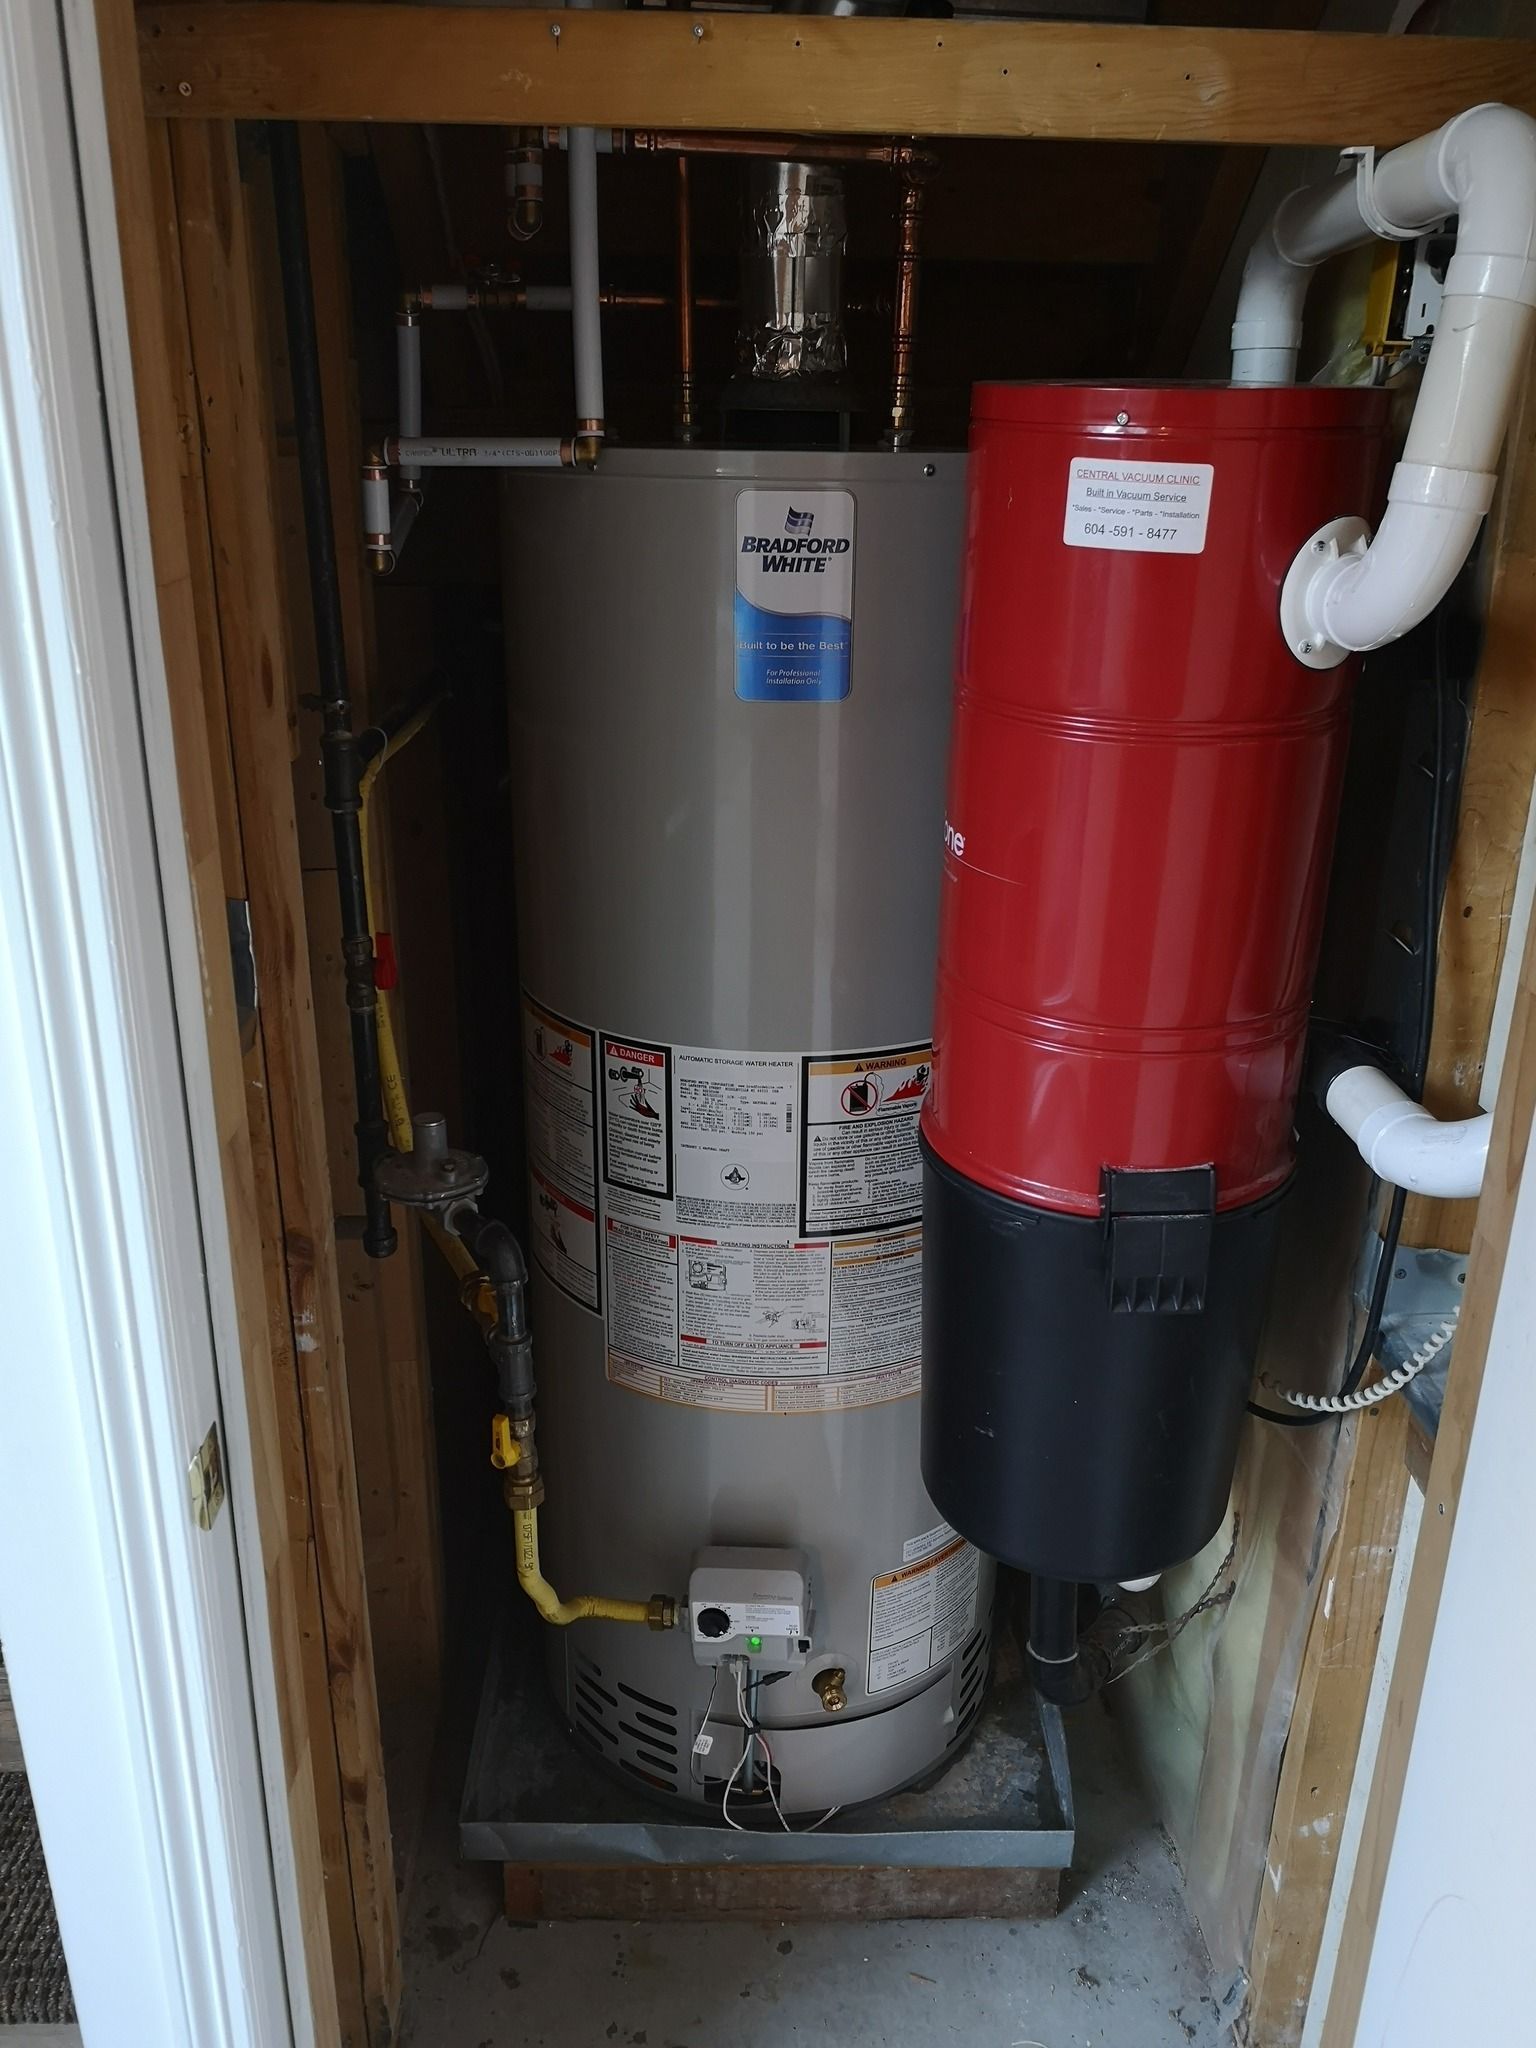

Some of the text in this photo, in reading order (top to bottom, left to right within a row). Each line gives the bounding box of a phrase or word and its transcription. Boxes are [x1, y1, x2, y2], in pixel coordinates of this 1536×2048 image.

[442, 448, 476, 457] ULTRA
[1076, 468, 1200, 485] CENTRAL VACUUM CLINIC
[1086, 487, 1187, 502] Built in Vacuum Service
[1084, 523, 1105, 535] 604
[1146, 528, 1178, 540] 8477
[741, 536, 850, 554] BRADFORD
[762, 555, 826, 573] WHITE
[739, 641, 844, 651] Built to be the Best
[778, 669, 821, 677] Professional
[806, 677, 822, 686] Only
[619, 1048, 655, 1064] DANGER
[679, 1055, 713, 1064] AUTOMATIC
[865, 1058, 906, 1070] WARNING
[902, 1562, 930, 1578] WARNING
